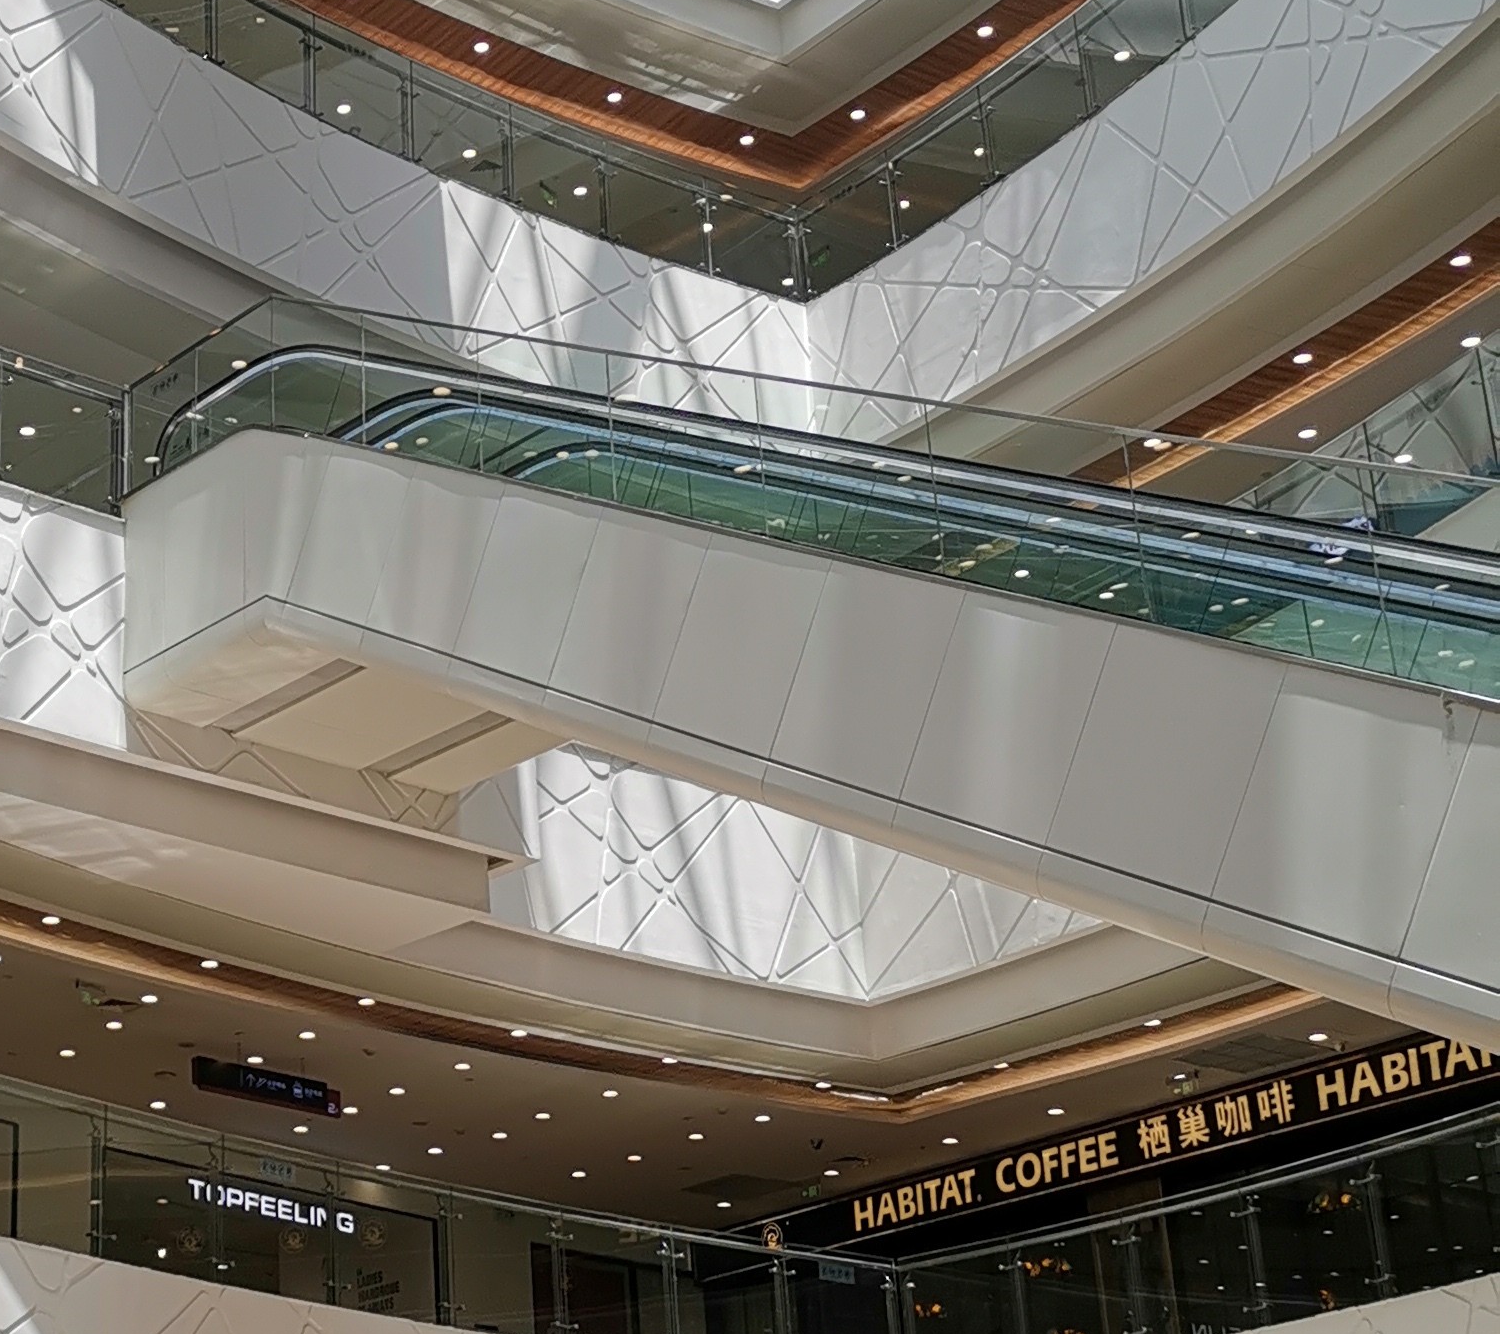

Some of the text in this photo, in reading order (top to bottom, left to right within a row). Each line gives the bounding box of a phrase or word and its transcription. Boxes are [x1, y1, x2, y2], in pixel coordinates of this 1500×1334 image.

[188, 1178, 355, 1233] TOPFEELING
[853, 1168, 976, 1231] HABITAT
[995, 1131, 1119, 1194] COFFEE
[1137, 1079, 1296, 1160] 栖巢咖啡
